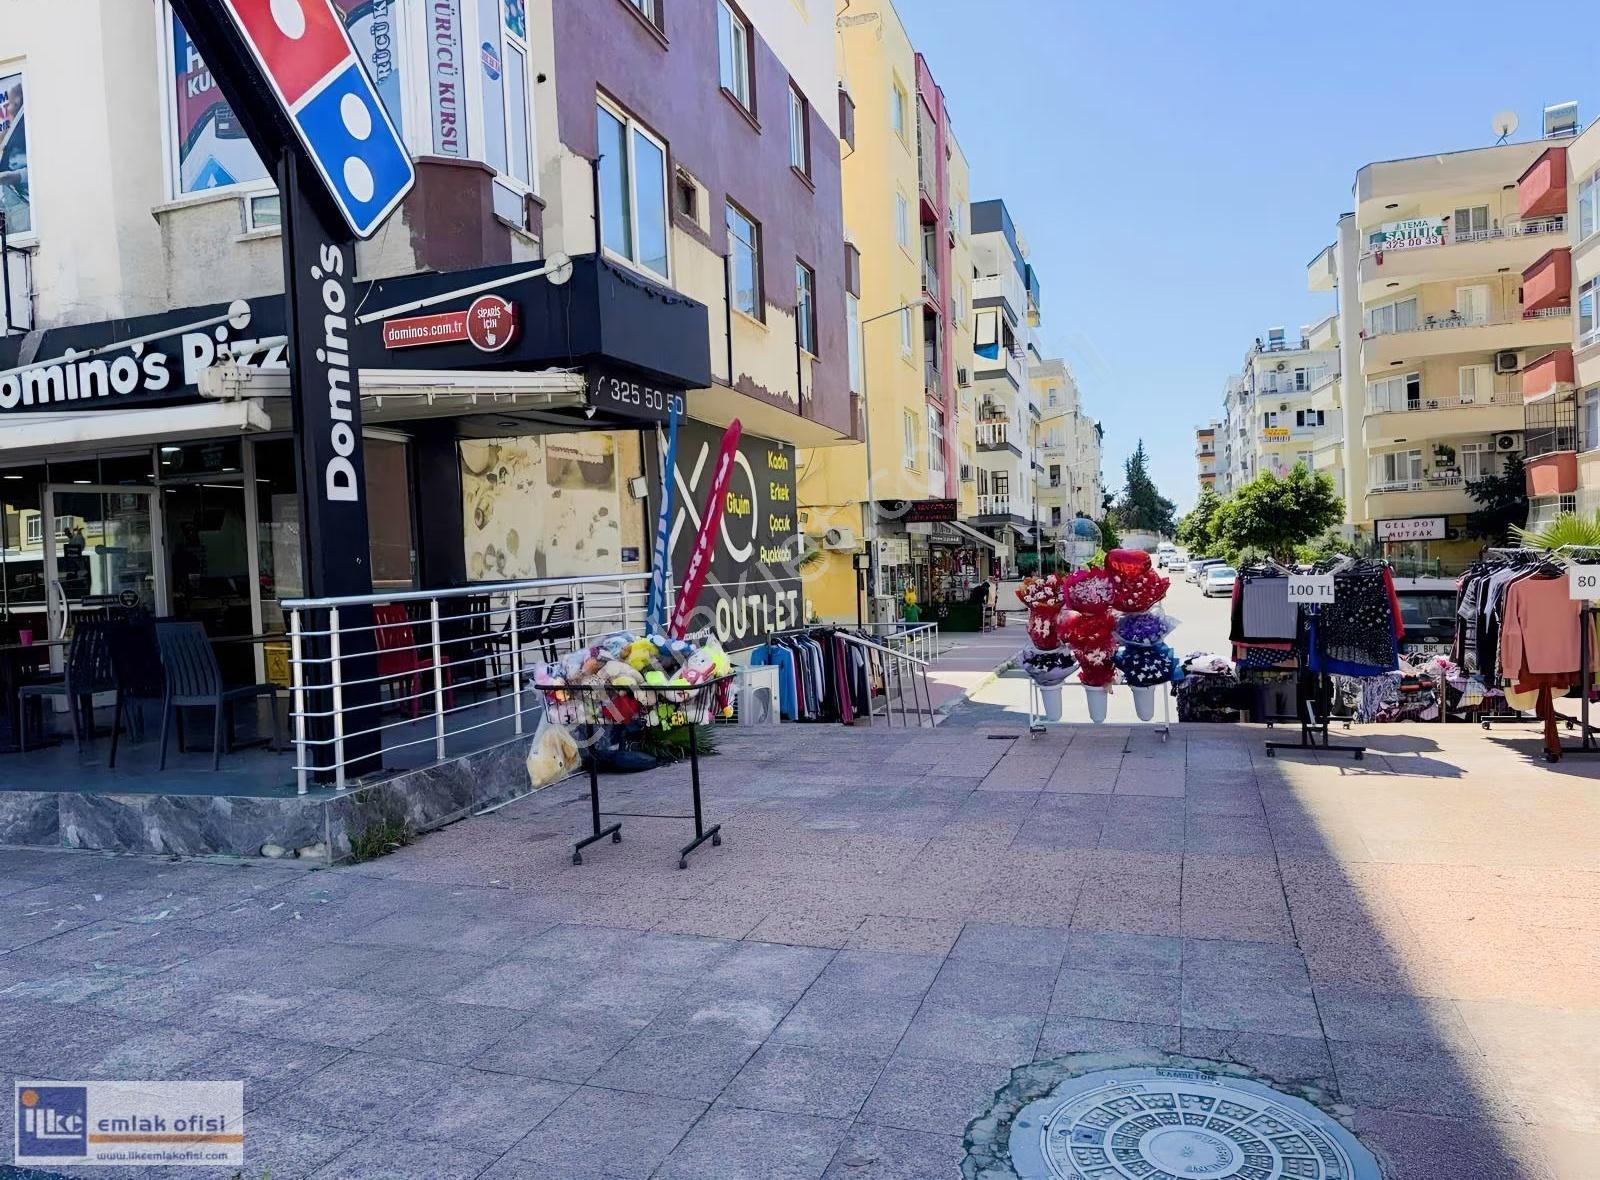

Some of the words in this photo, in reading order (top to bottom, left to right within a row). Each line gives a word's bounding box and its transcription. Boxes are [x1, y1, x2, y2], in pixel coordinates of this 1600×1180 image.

[370, 20, 392, 84] RÜCÜ
[435, 0, 459, 76] ÜRÜCÜ
[438, 81, 458, 154] KURSU
[388, 320, 463, 341] dominos.com.tr
[0, 341, 170, 409] omino's
[182, 325, 289, 385] Pizz
[311, 243, 359, 501] Domino's
[610, 378, 641, 405] 325
[645, 386, 663, 411] 50
[667, 393, 683, 416] 50
[768, 450, 788, 471] Kadın
[726, 492, 751, 518] Giyim
[770, 482, 790, 501] Erkek
[769, 514, 791, 538] Çocuk
[1289, 585, 1314, 596] 100
[1318, 585, 1333, 596] TL
[1578, 575, 1596, 588] 80
[715, 590, 798, 643] OUTLET
